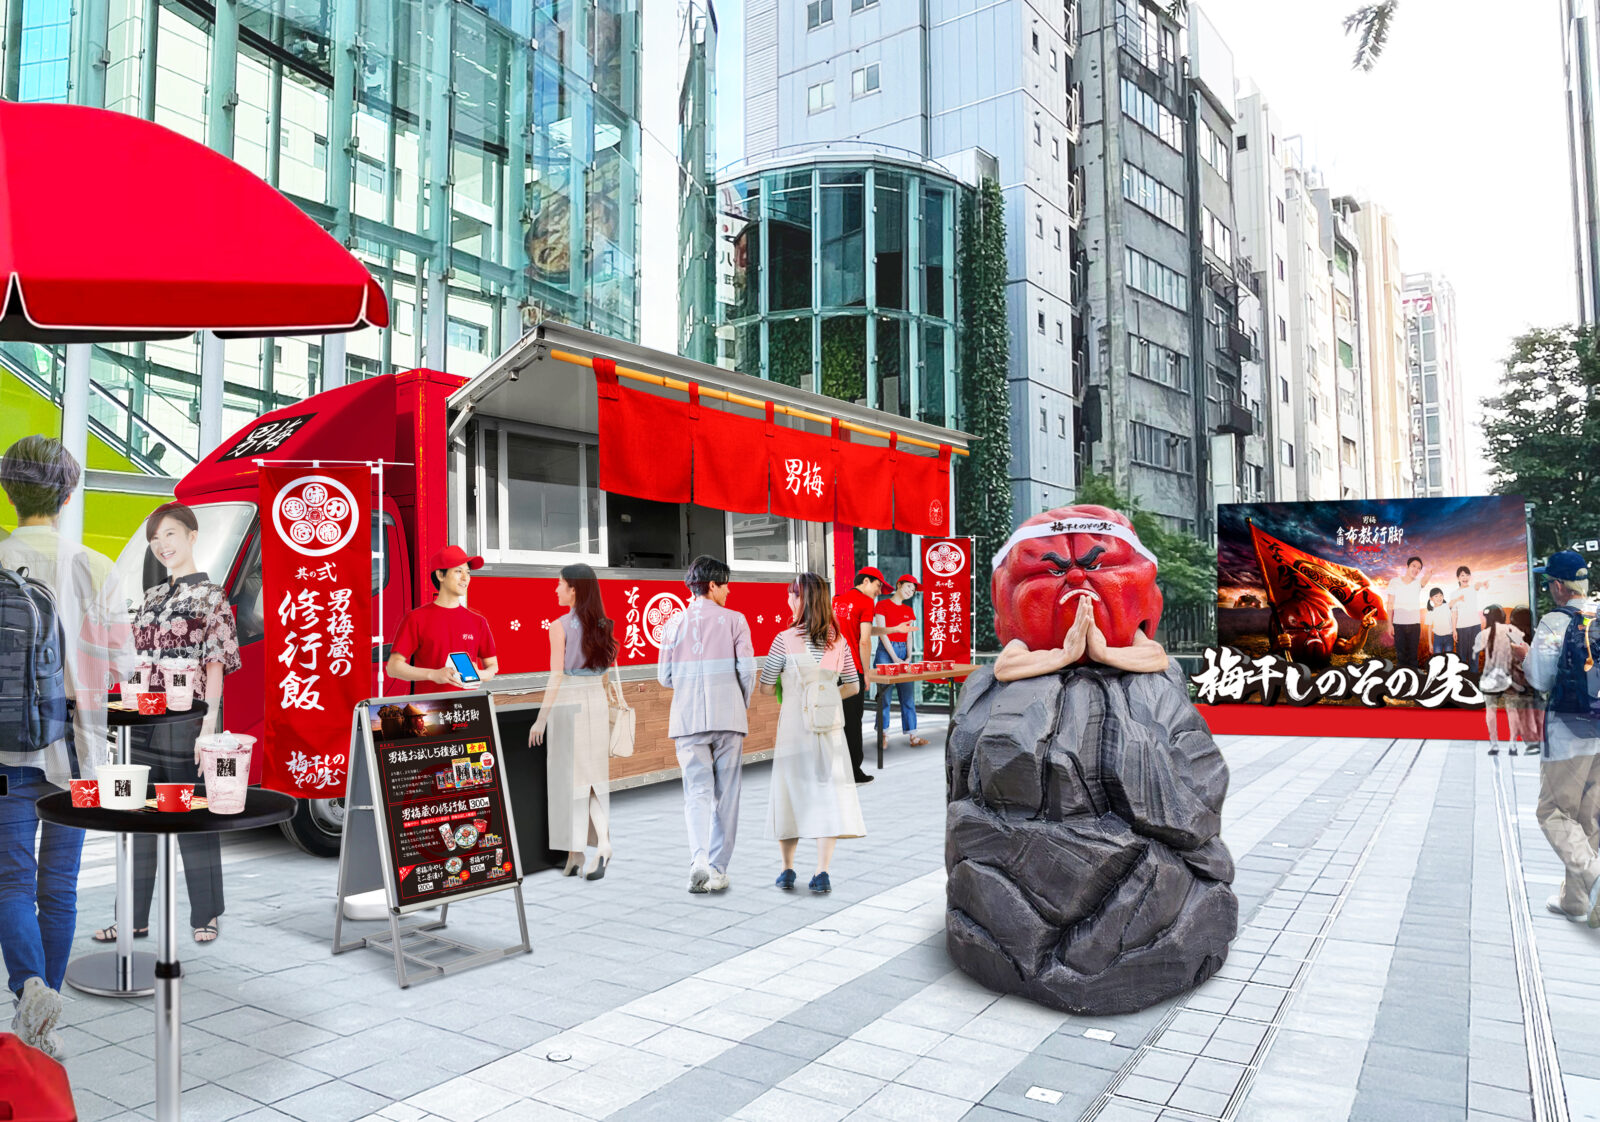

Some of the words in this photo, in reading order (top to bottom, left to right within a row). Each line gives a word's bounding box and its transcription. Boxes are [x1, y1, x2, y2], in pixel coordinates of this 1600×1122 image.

[226, 418, 302, 457] 男梅
[785, 459, 824, 498] 男梅
[1345, 525, 1404, 545] 布教行脚
[294, 561, 338, 583] 其の弐
[326, 588, 355, 677] 男梅蔵の
[624, 586, 646, 659] その先へ
[928, 591, 948, 658] 5種盛り
[948, 591, 962, 644] 男梅お試し
[277, 587, 325, 711] 修行飯
[285, 750, 345, 775] 梅干しの
[388, 744, 465, 764] 男梅お試し5種盛り
[293, 767, 347, 790] その先へ
[402, 800, 468, 821] 男梅蔵の修行飯
